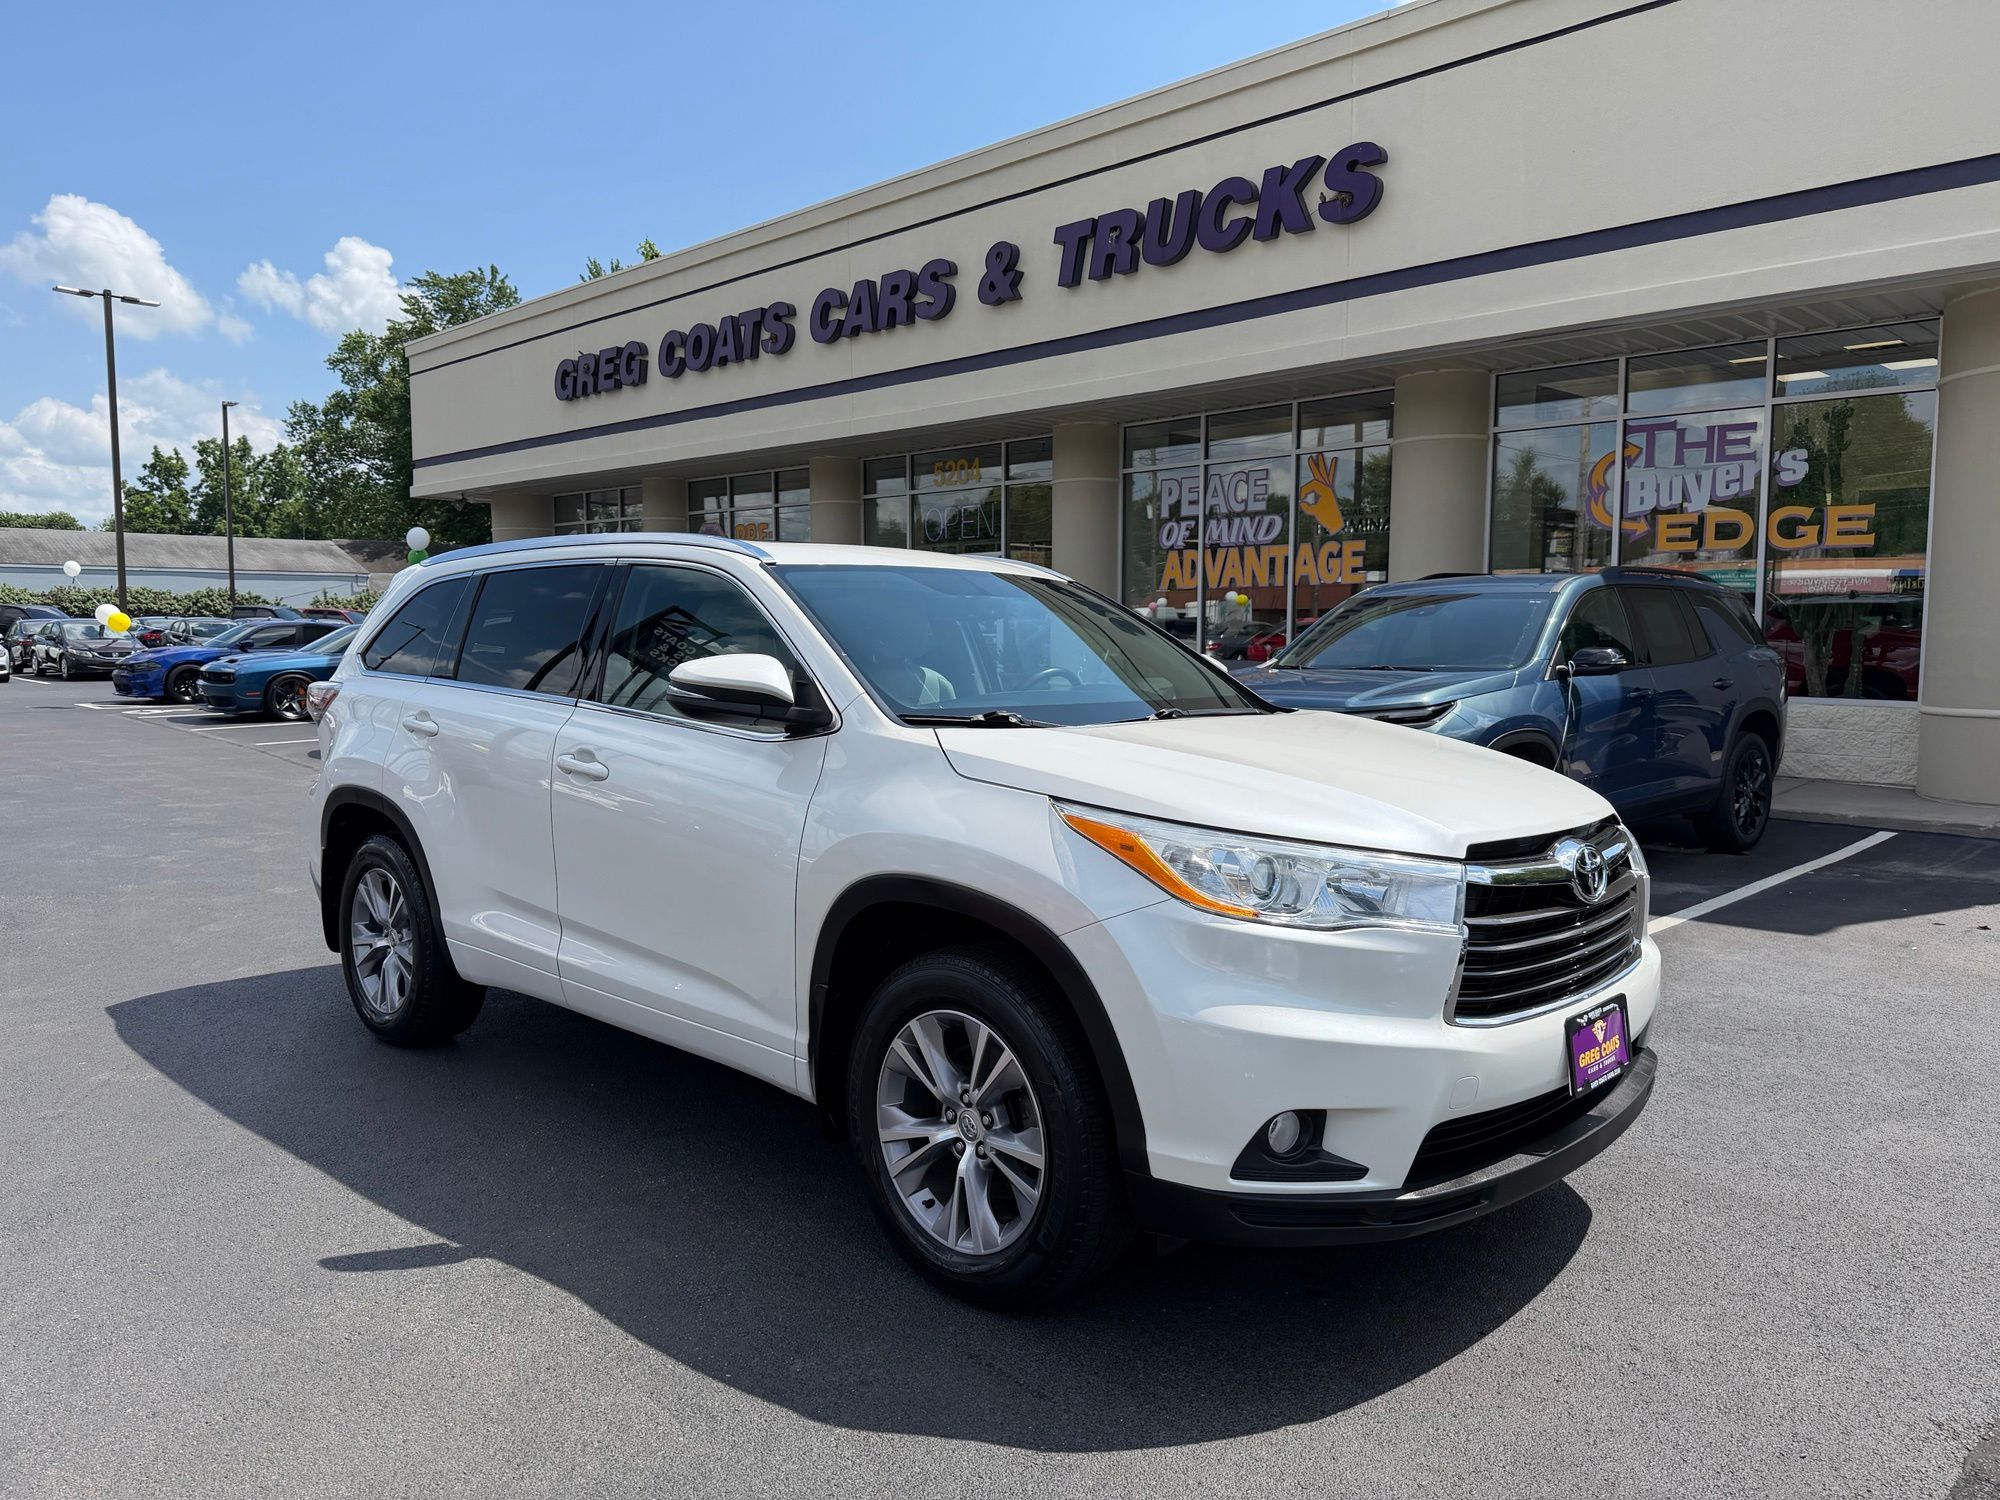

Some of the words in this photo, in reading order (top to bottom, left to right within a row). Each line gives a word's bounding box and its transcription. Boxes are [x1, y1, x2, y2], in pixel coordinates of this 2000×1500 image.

[554, 345, 647, 401] GREG
[658, 301, 795, 378] COATS
[810, 258, 958, 345] CARS
[978, 241, 1024, 306] &
[1053, 141, 1388, 288] TRUCKS
[1625, 419, 1759, 469] THE
[932, 457, 982, 488] 5204
[1160, 468, 1270, 519] PEACE
[924, 503, 996, 542] OPEN
[1159, 520, 1196, 550] OF
[1204, 513, 1284, 548] MIND
[1654, 503, 1877, 553] EDGE
[1159, 539, 1368, 590] ADVANTAGE
[1579, 1046, 1600, 1068] GREG
[1601, 1034, 1620, 1057] COATS
